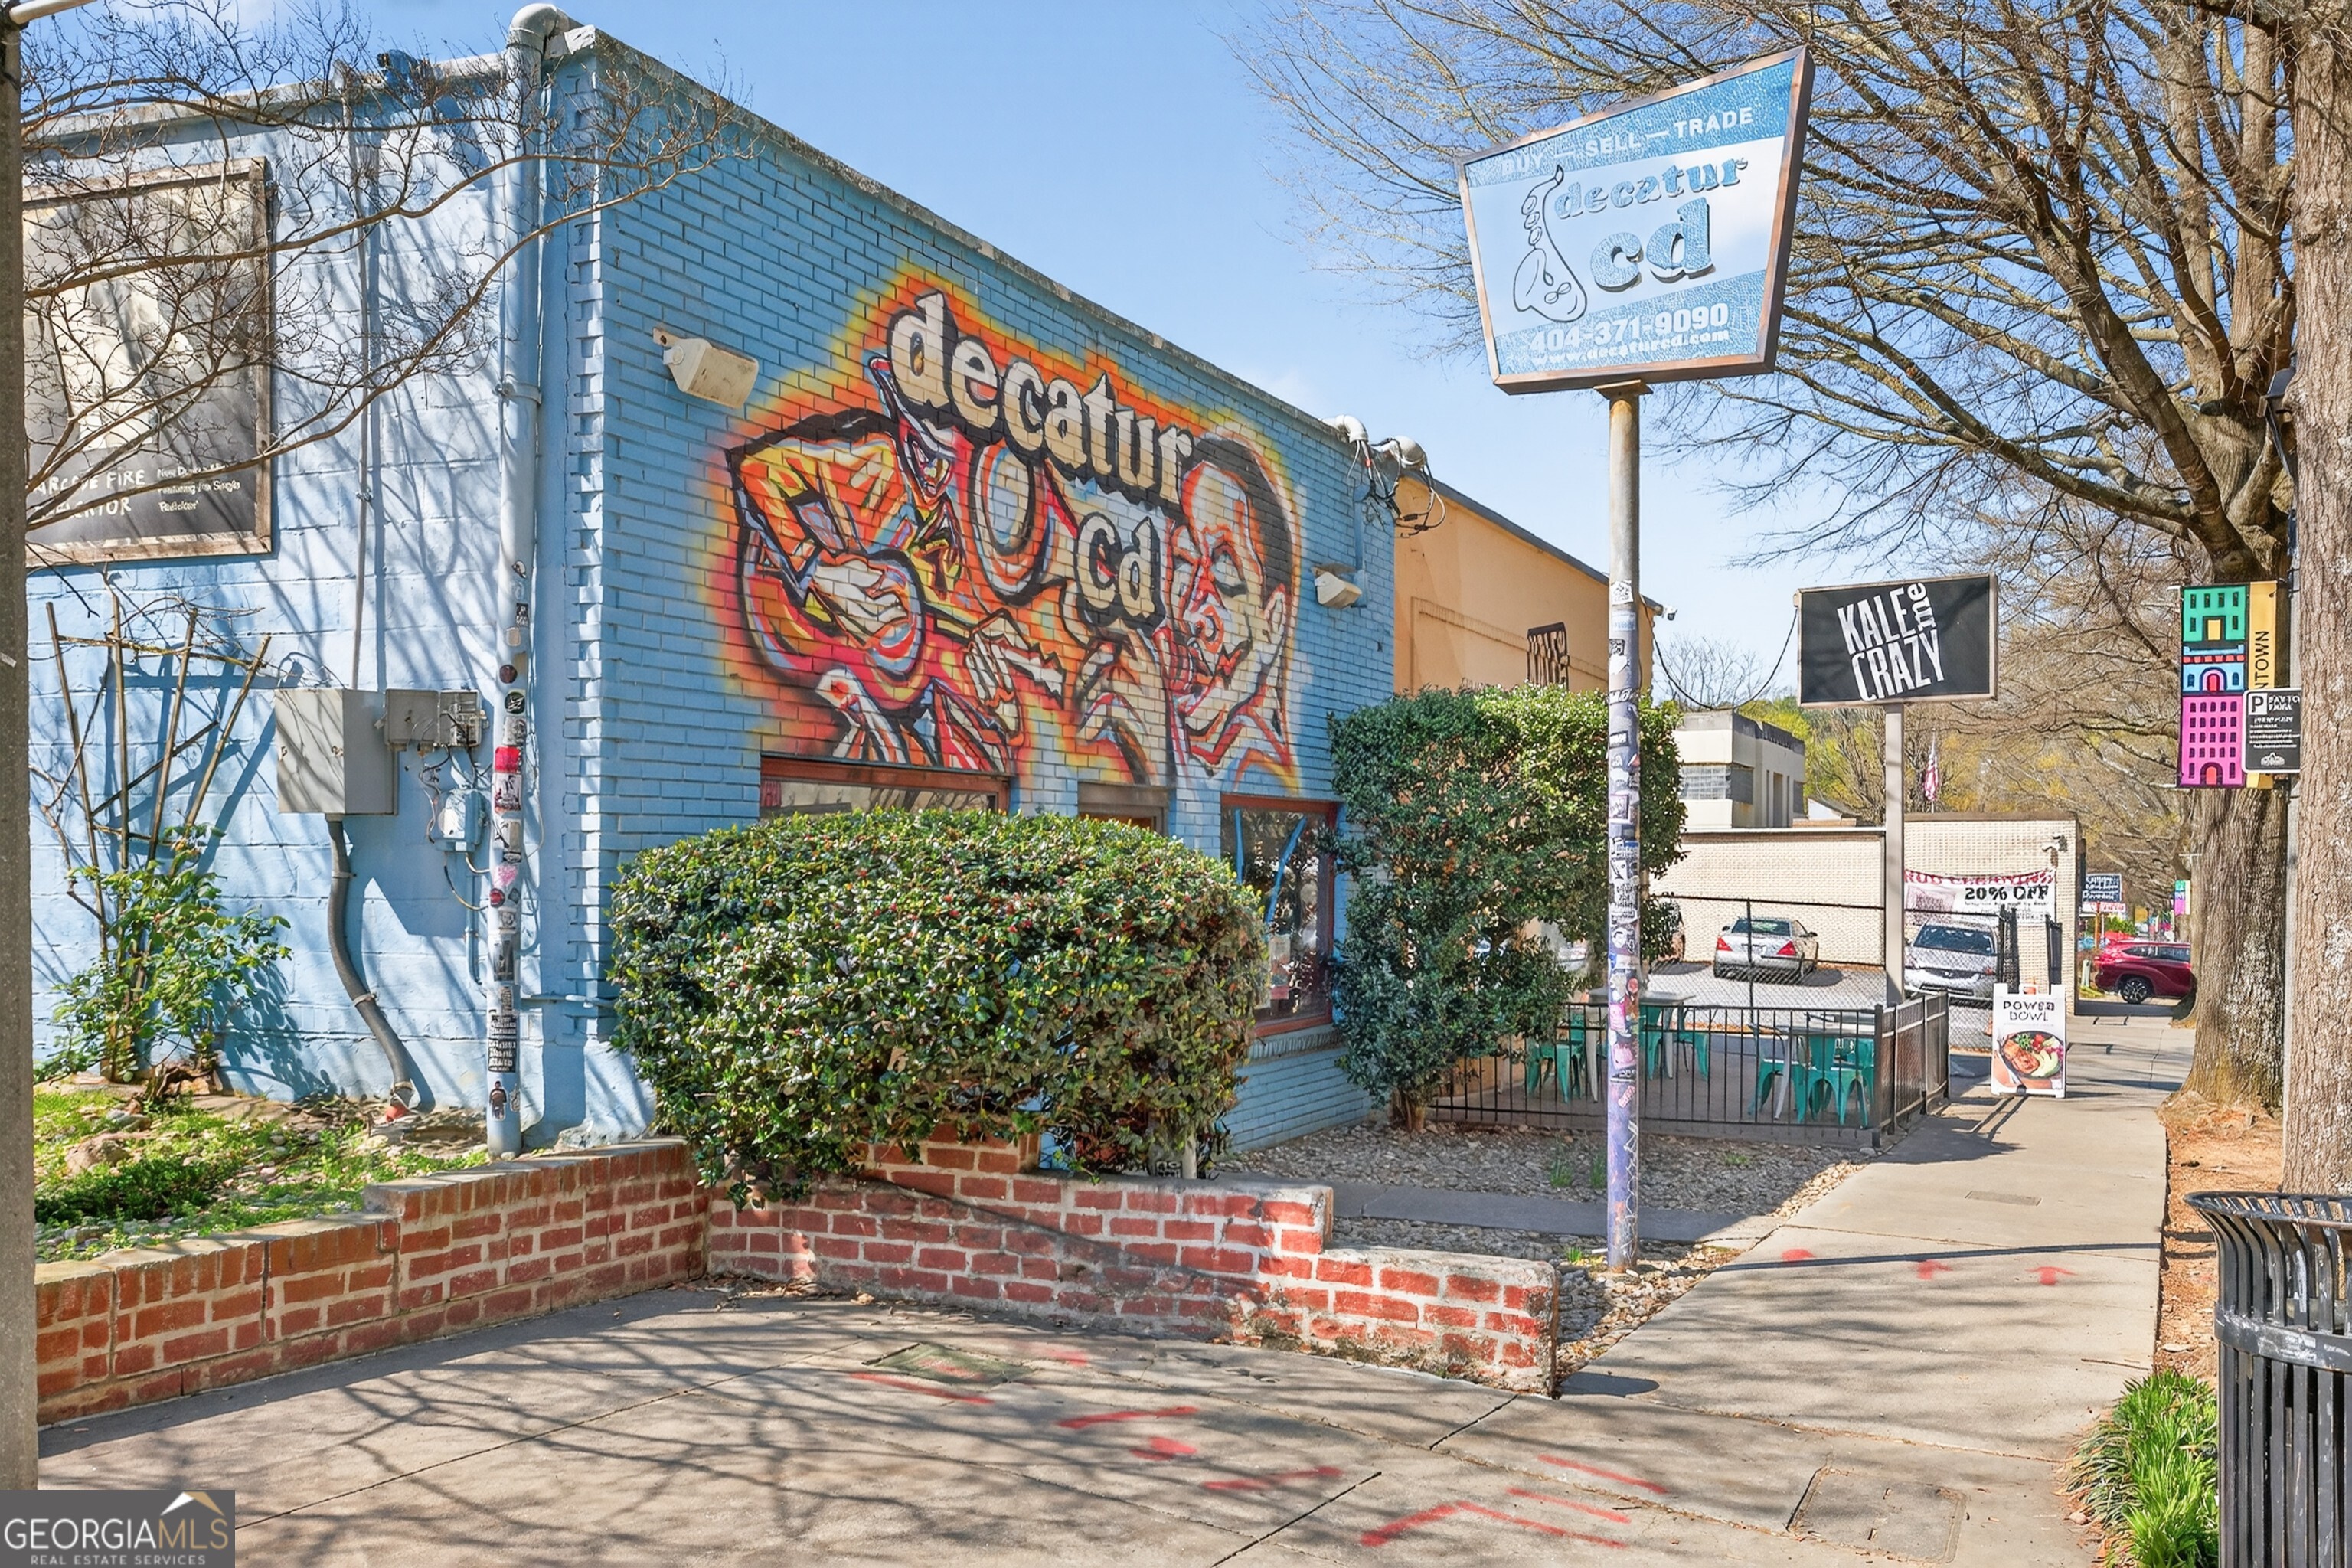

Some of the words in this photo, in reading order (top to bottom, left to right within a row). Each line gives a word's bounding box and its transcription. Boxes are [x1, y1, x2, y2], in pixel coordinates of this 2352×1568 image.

[1501, 155, 1544, 175] BUY
[1585, 132, 1642, 158] SELL
[1674, 106, 1754, 139] TRADE
[1554, 157, 1748, 219] decatur
[1590, 197, 1715, 292] cd
[1531, 329, 1730, 364] www.decaturcd.com
[1532, 303, 1729, 353] 404-371-9090
[888, 291, 1194, 503] decatur
[106, 469, 146, 489] FIRE
[1837, 586, 1916, 655] KALE
[1907, 582, 1937, 632] me
[1851, 629, 1945, 701] CRAZY
[2251, 695, 2264, 713] P
[1965, 886, 2008, 900] 20%
[2013, 884, 2050, 900] OFF
[2003, 1001, 2055, 1011] POWER
[2009, 1011, 2049, 1021] BOWL
